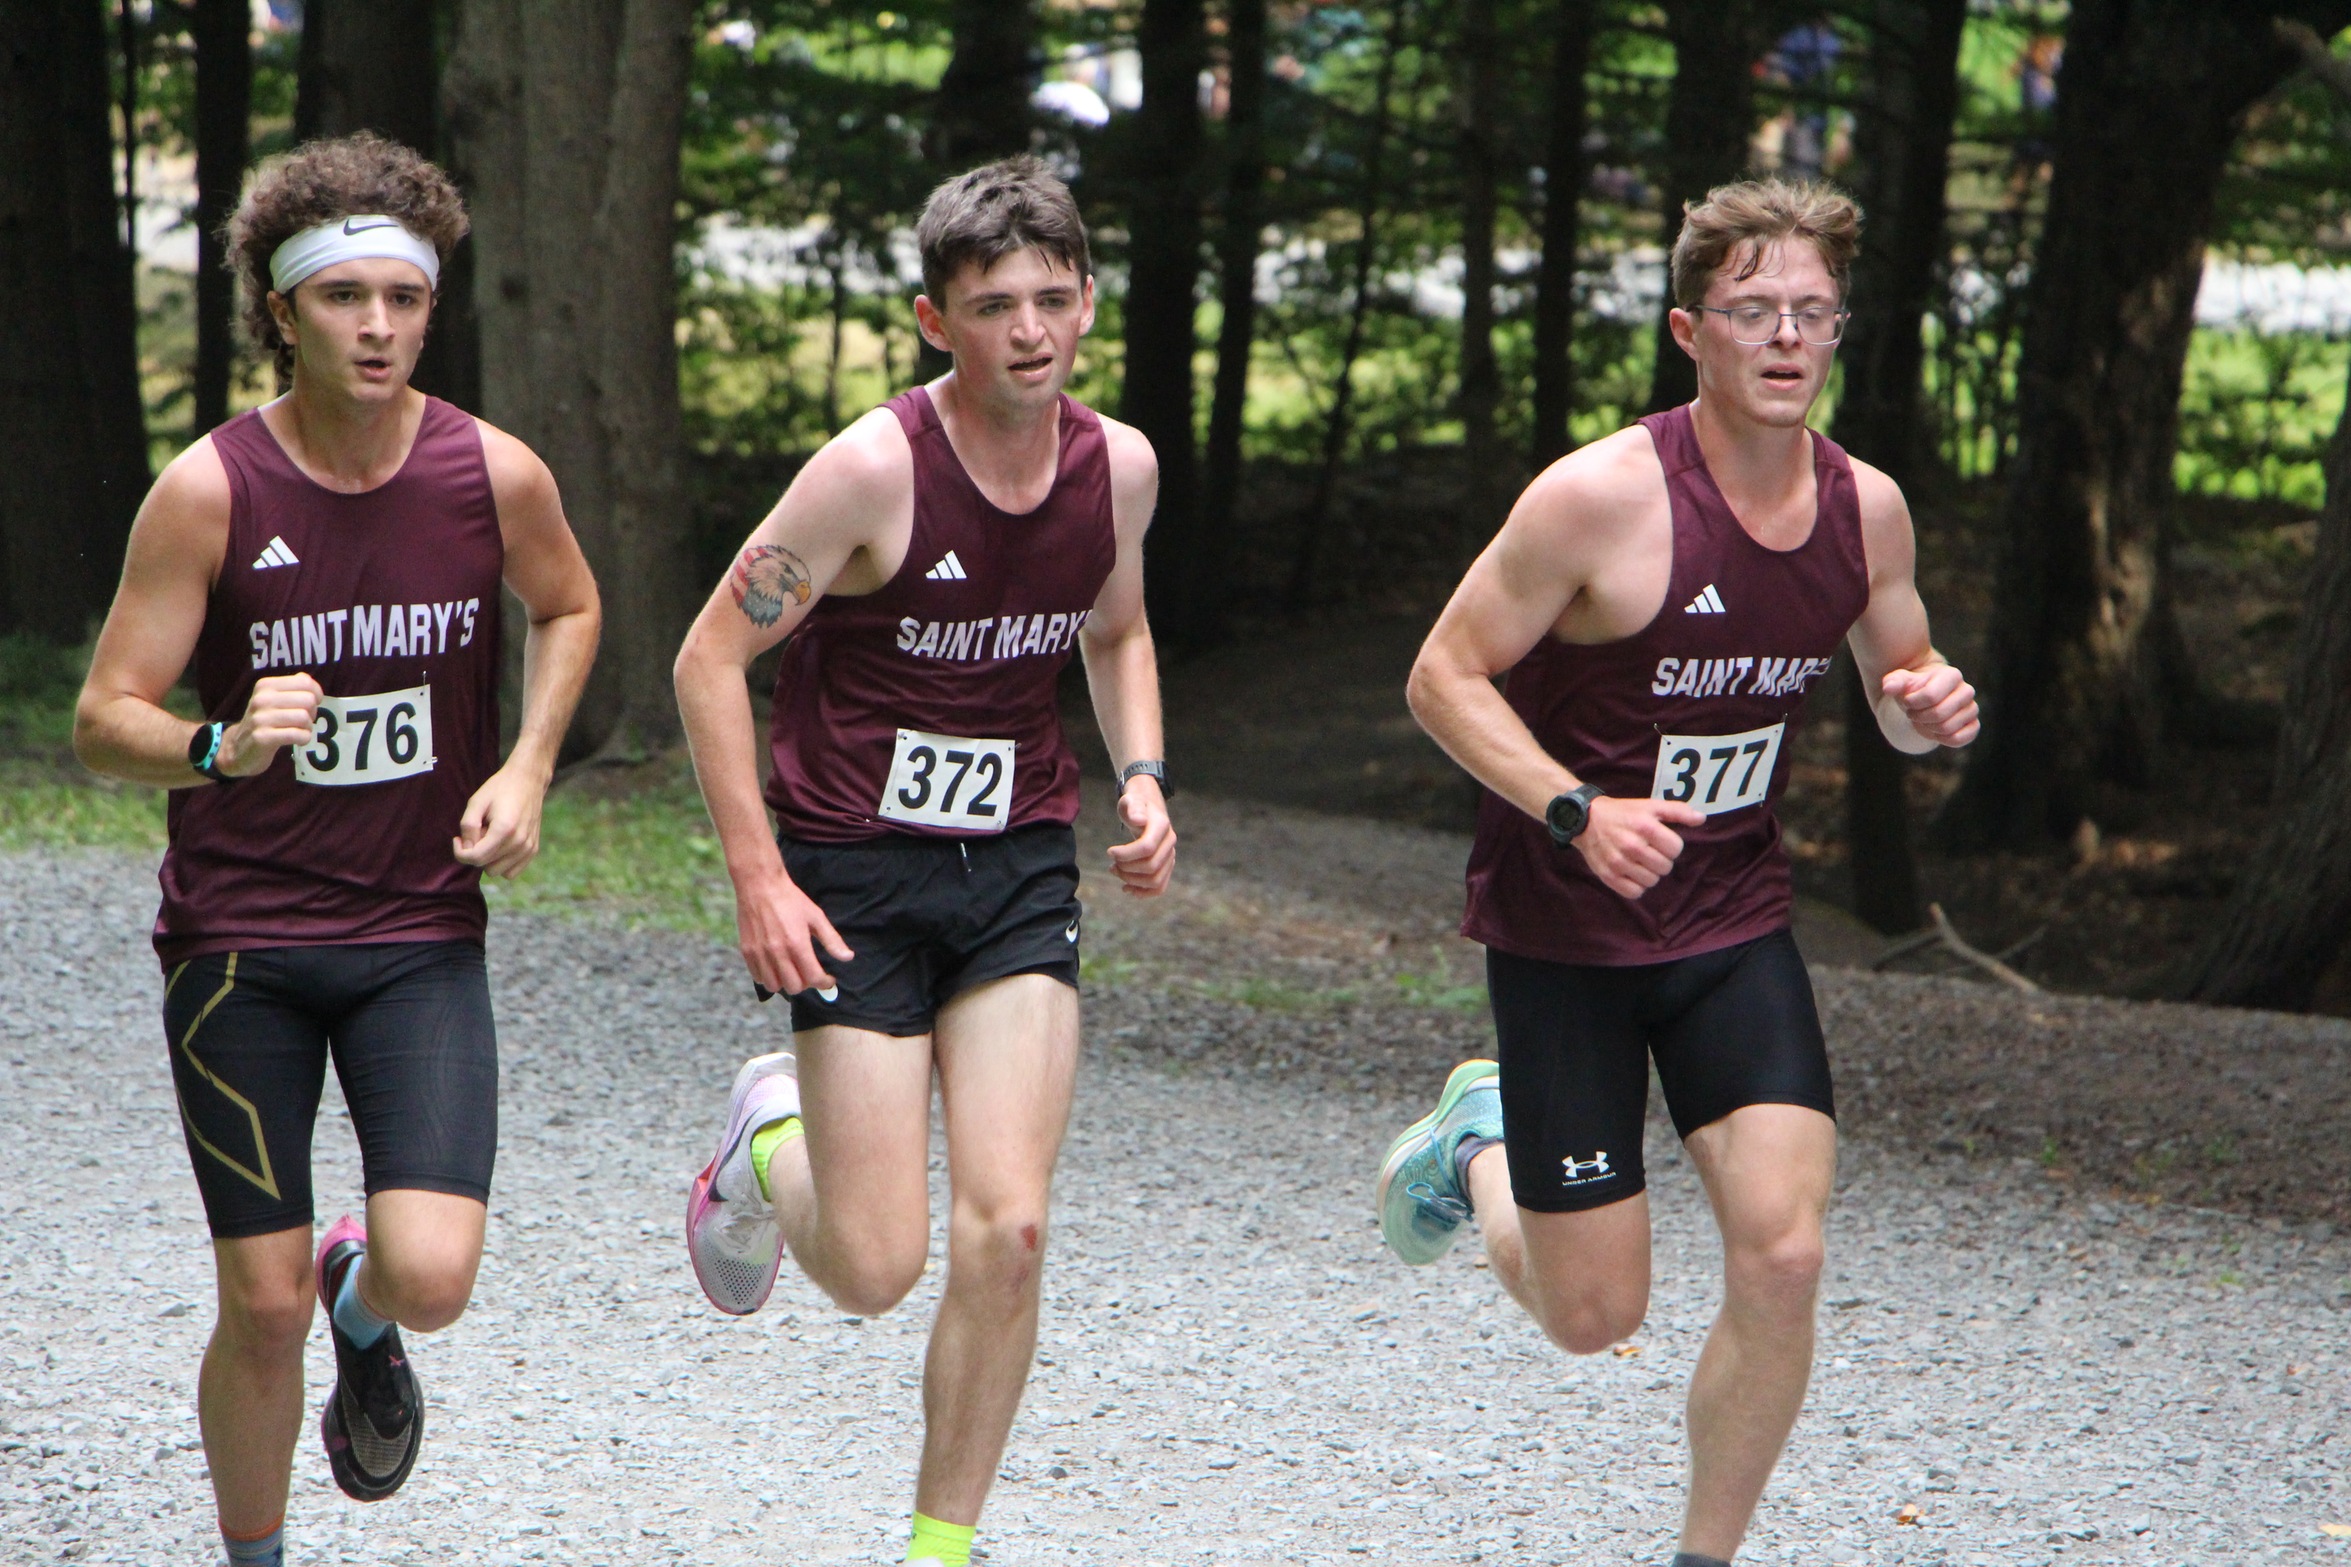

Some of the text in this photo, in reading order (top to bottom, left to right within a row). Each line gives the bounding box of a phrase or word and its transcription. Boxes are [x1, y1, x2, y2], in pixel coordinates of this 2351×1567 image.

[250, 598, 480, 670] SAINT MARY'S
[897, 617, 993, 660] SAINT
[1651, 657, 1753, 698] SAINT
[306, 702, 418, 772] 376
[898, 745, 1003, 817] 372
[1663, 739, 1769, 803] 377
